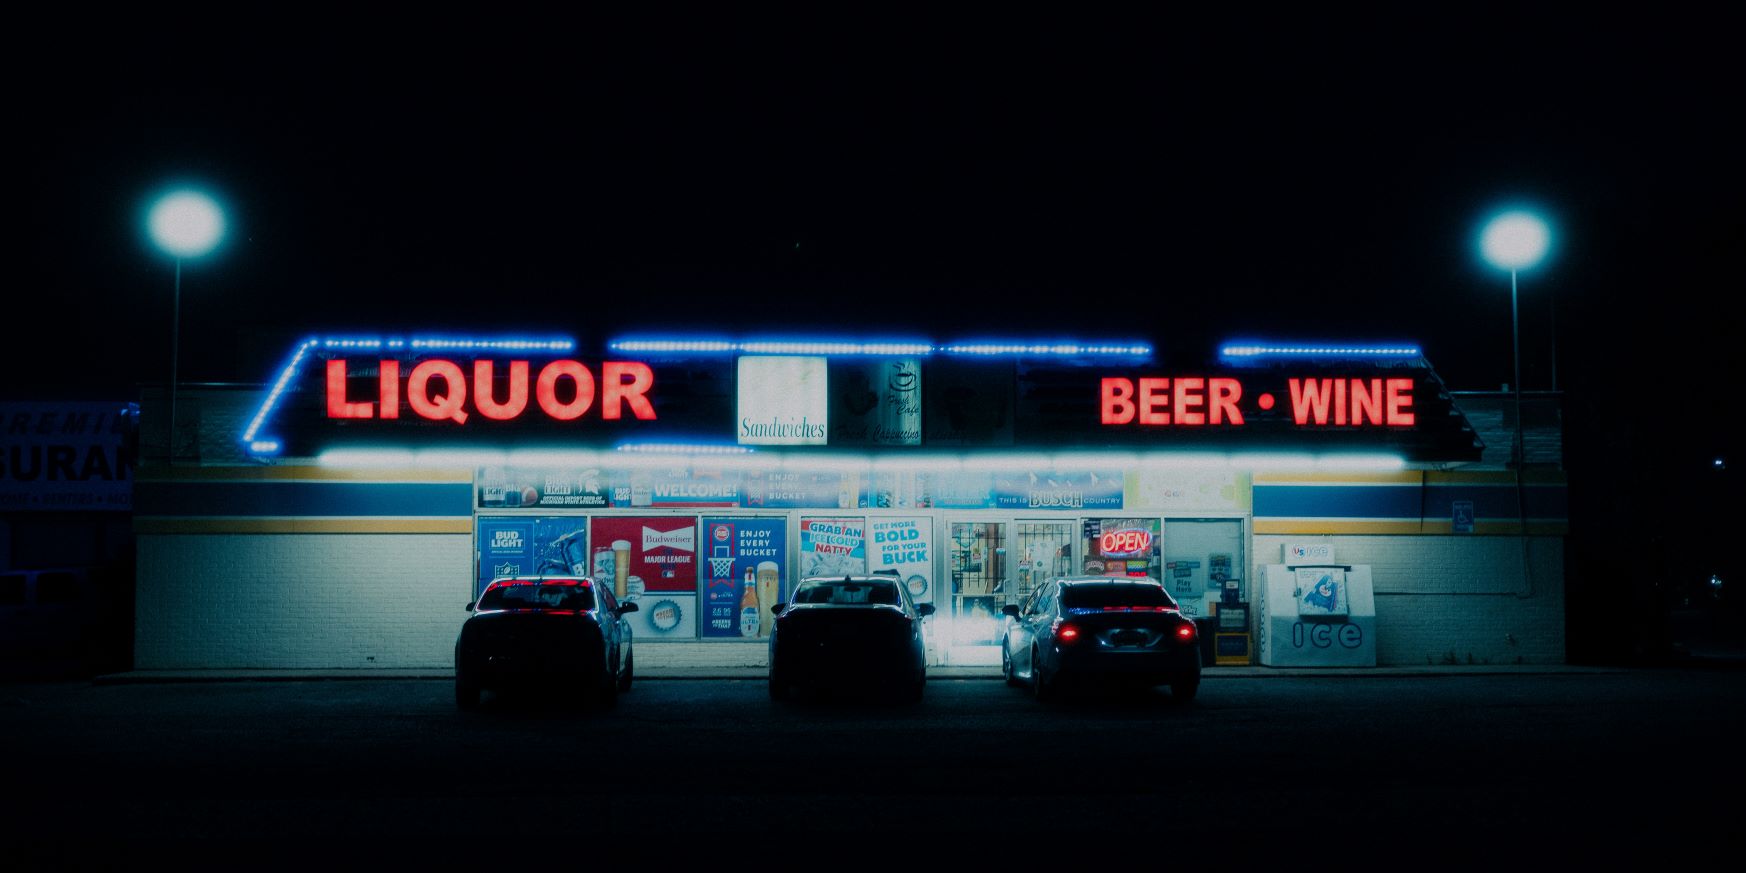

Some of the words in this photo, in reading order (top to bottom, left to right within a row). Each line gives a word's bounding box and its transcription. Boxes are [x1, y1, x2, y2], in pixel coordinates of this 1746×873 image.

[326, 359, 658, 425] LIQUOR
[1100, 377, 1245, 426] BEER
[1288, 377, 1415, 426] WINE
[740, 416, 825, 439] Sandwiches
[654, 483, 738, 498] WELCOME!
[1029, 489, 1083, 508] BUSCH
[873, 523, 889, 531] GET
[890, 521, 916, 529] MORE
[495, 530, 519, 539] BUD
[645, 534, 692, 544] Budweiser
[739, 530, 771, 538] ENJOY
[874, 528, 920, 543] BOLD
[491, 539, 523, 548] LIGHT
[739, 539, 770, 547] EVERY
[901, 542, 927, 550] YOUR
[1101, 532, 1149, 551] OPEN
[739, 548, 777, 556] BUCKET
[815, 543, 852, 556] NATTY
[644, 555, 665, 564] MAJOR
[666, 555, 692, 564] LEAGUE
[882, 550, 929, 565] BUCK
